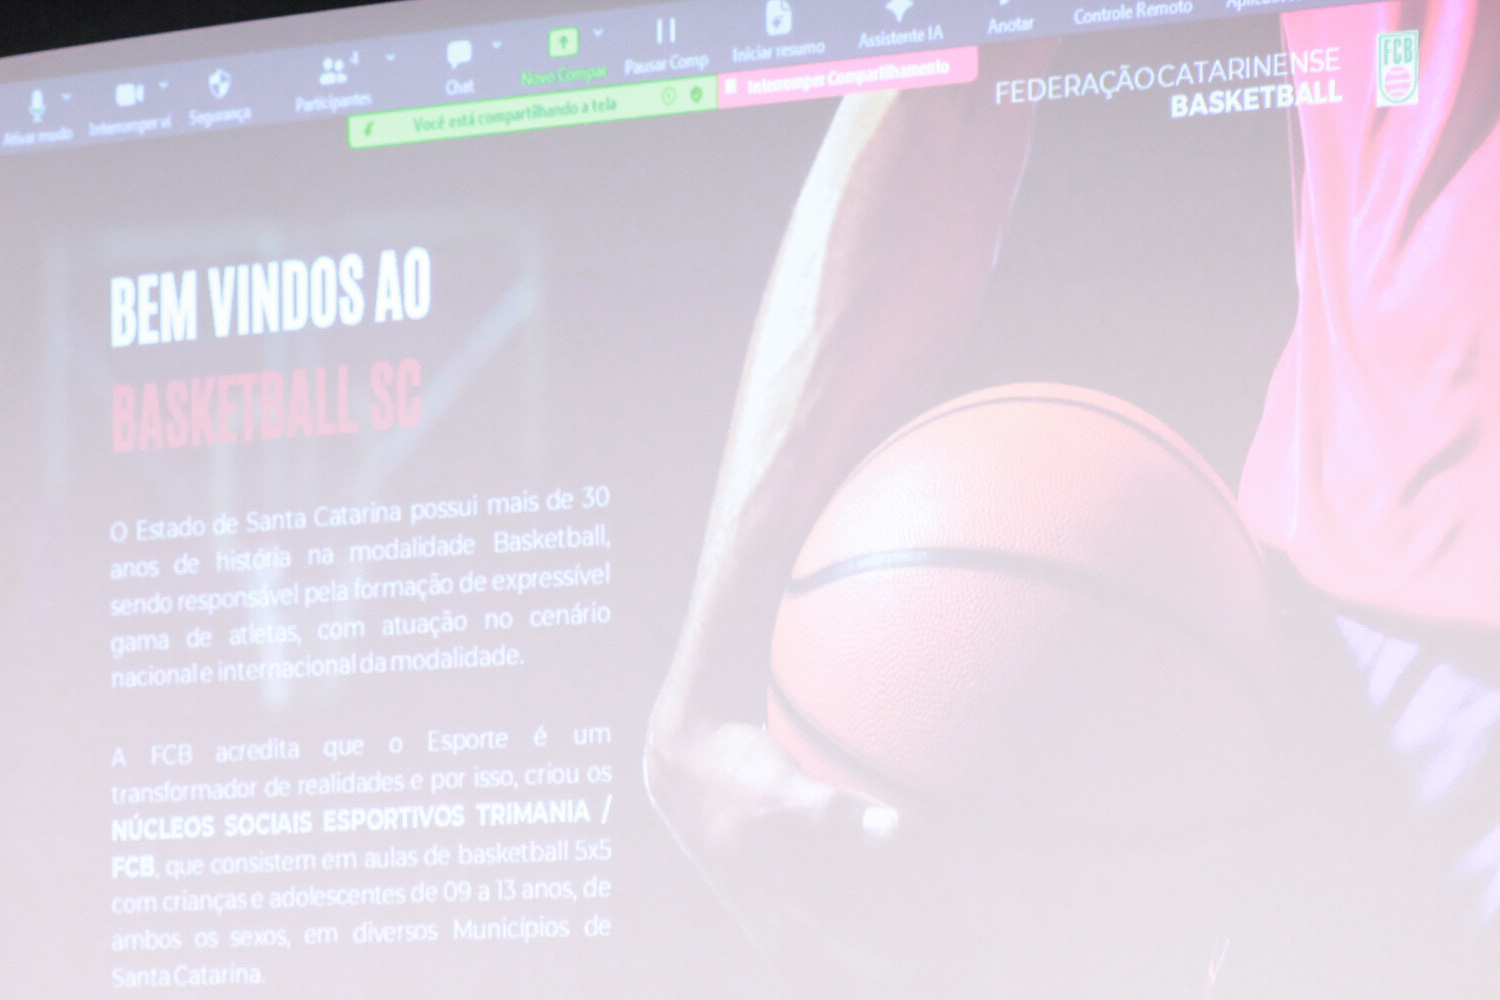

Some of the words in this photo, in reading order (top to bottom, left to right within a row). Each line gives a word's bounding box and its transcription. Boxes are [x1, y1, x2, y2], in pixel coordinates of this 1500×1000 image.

[987, 18, 1034, 34] Anotar
[1074, 5, 1133, 24] Controle
[1136, 0, 1193, 17] Remoto
[732, 45, 772, 62] Iniciar
[776, 42, 825, 58] resumo
[858, 28, 925, 48] Assistente
[928, 25, 944, 40] IA
[1384, 38, 1413, 65] FCB
[521, 71, 556, 86] Novo
[624, 58, 667, 75] Pausar
[670, 52, 709, 72] Comp
[828, 59, 950, 86] Compartilhamento
[445, 79, 474, 96] Chat
[1170, 79, 1343, 118] BASKETBALL
[413, 114, 445, 132] Você
[448, 111, 475, 128] está
[478, 102, 578, 128] compartilhando
[580, 102, 589, 113] a
[591, 96, 617, 112] tela
[110, 270, 197, 348] BEM
[208, 253, 364, 338] VINDOS
[374, 246, 431, 323] AO
[112, 364, 358, 454] BASKETBALL
[370, 357, 422, 431] SC
[110, 521, 128, 543] O
[136, 516, 206, 541] Estado
[212, 512, 238, 536] de
[246, 510, 306, 533] Santa
[314, 502, 401, 528] Catarina
[410, 493, 478, 526] possui
[486, 490, 538, 515] mais
[546, 488, 574, 512] de
[582, 485, 610, 509] 30
[110, 559, 159, 580] anos
[174, 553, 199, 575] de
[216, 546, 291, 572] história
[308, 547, 334, 564] na
[350, 533, 475, 563] modalidade
[493, 523, 610, 554] Basketball,
[110, 592, 172, 616] sendo
[178, 582, 298, 615] responsável
[304, 581, 348, 608] pela
[354, 572, 453, 601] formação
[459, 571, 487, 593] de
[492, 561, 610, 594] expressível
[110, 632, 169, 658] gama
[186, 627, 212, 648] de
[230, 623, 302, 646] atletas,
[317, 620, 364, 640] com
[382, 610, 467, 638] atuação
[484, 611, 513, 630] no
[529, 600, 611, 628] cenário
[111, 663, 198, 688] nacional
[200, 666, 212, 684] e
[218, 653, 356, 682] internacional
[360, 652, 386, 674] da
[391, 644, 525, 671] modalidade.
[111, 747, 126, 766] A
[151, 744, 192, 765] FCB
[216, 738, 299, 763] acredita
[323, 738, 364, 760] que
[388, 736, 402, 754] o
[428, 730, 508, 754] Esporte
[534, 726, 548, 746] é
[574, 726, 610, 745] um
[111, 780, 257, 804] transformador
[264, 778, 290, 798] de
[298, 773, 404, 796] realidades
[410, 773, 424, 790] e
[431, 771, 466, 794] por
[474, 766, 518, 790] isso,
[524, 764, 579, 786] criou
[587, 765, 612, 784] os
[111, 812, 214, 842] NÚCLEOS
[224, 811, 312, 836] SOCIAIS
[323, 804, 465, 832] ESPORTIVOS
[476, 800, 590, 826] TRIMANIA
[600, 794, 612, 825] /
[111, 854, 160, 880] FCB,
[165, 858, 204, 880] que
[211, 850, 316, 874] consistem
[322, 851, 357, 870] em
[364, 846, 417, 869] aulas
[423, 844, 450, 866] de
[458, 838, 568, 864] basketball
[574, 838, 612, 861] 5x5
[111, 894, 157, 914] com
[162, 889, 247, 916] crianças
[252, 892, 264, 908] e
[270, 882, 405, 908] adolescentes
[410, 880, 438, 902] de
[443, 880, 472, 901] 09
[477, 883, 490, 900] a
[496, 878, 516, 900] 13
[521, 879, 578, 902] anos,
[583, 876, 611, 898] de
[112, 927, 182, 952] ambos
[194, 930, 218, 948] os
[230, 926, 290, 950] sexos,
[304, 924, 338, 946] em
[353, 919, 438, 943] diversos
[453, 914, 570, 943] Municípios
[584, 914, 611, 936] de
[111, 965, 170, 988] Santa
[174, 962, 265, 986] Catarina.
